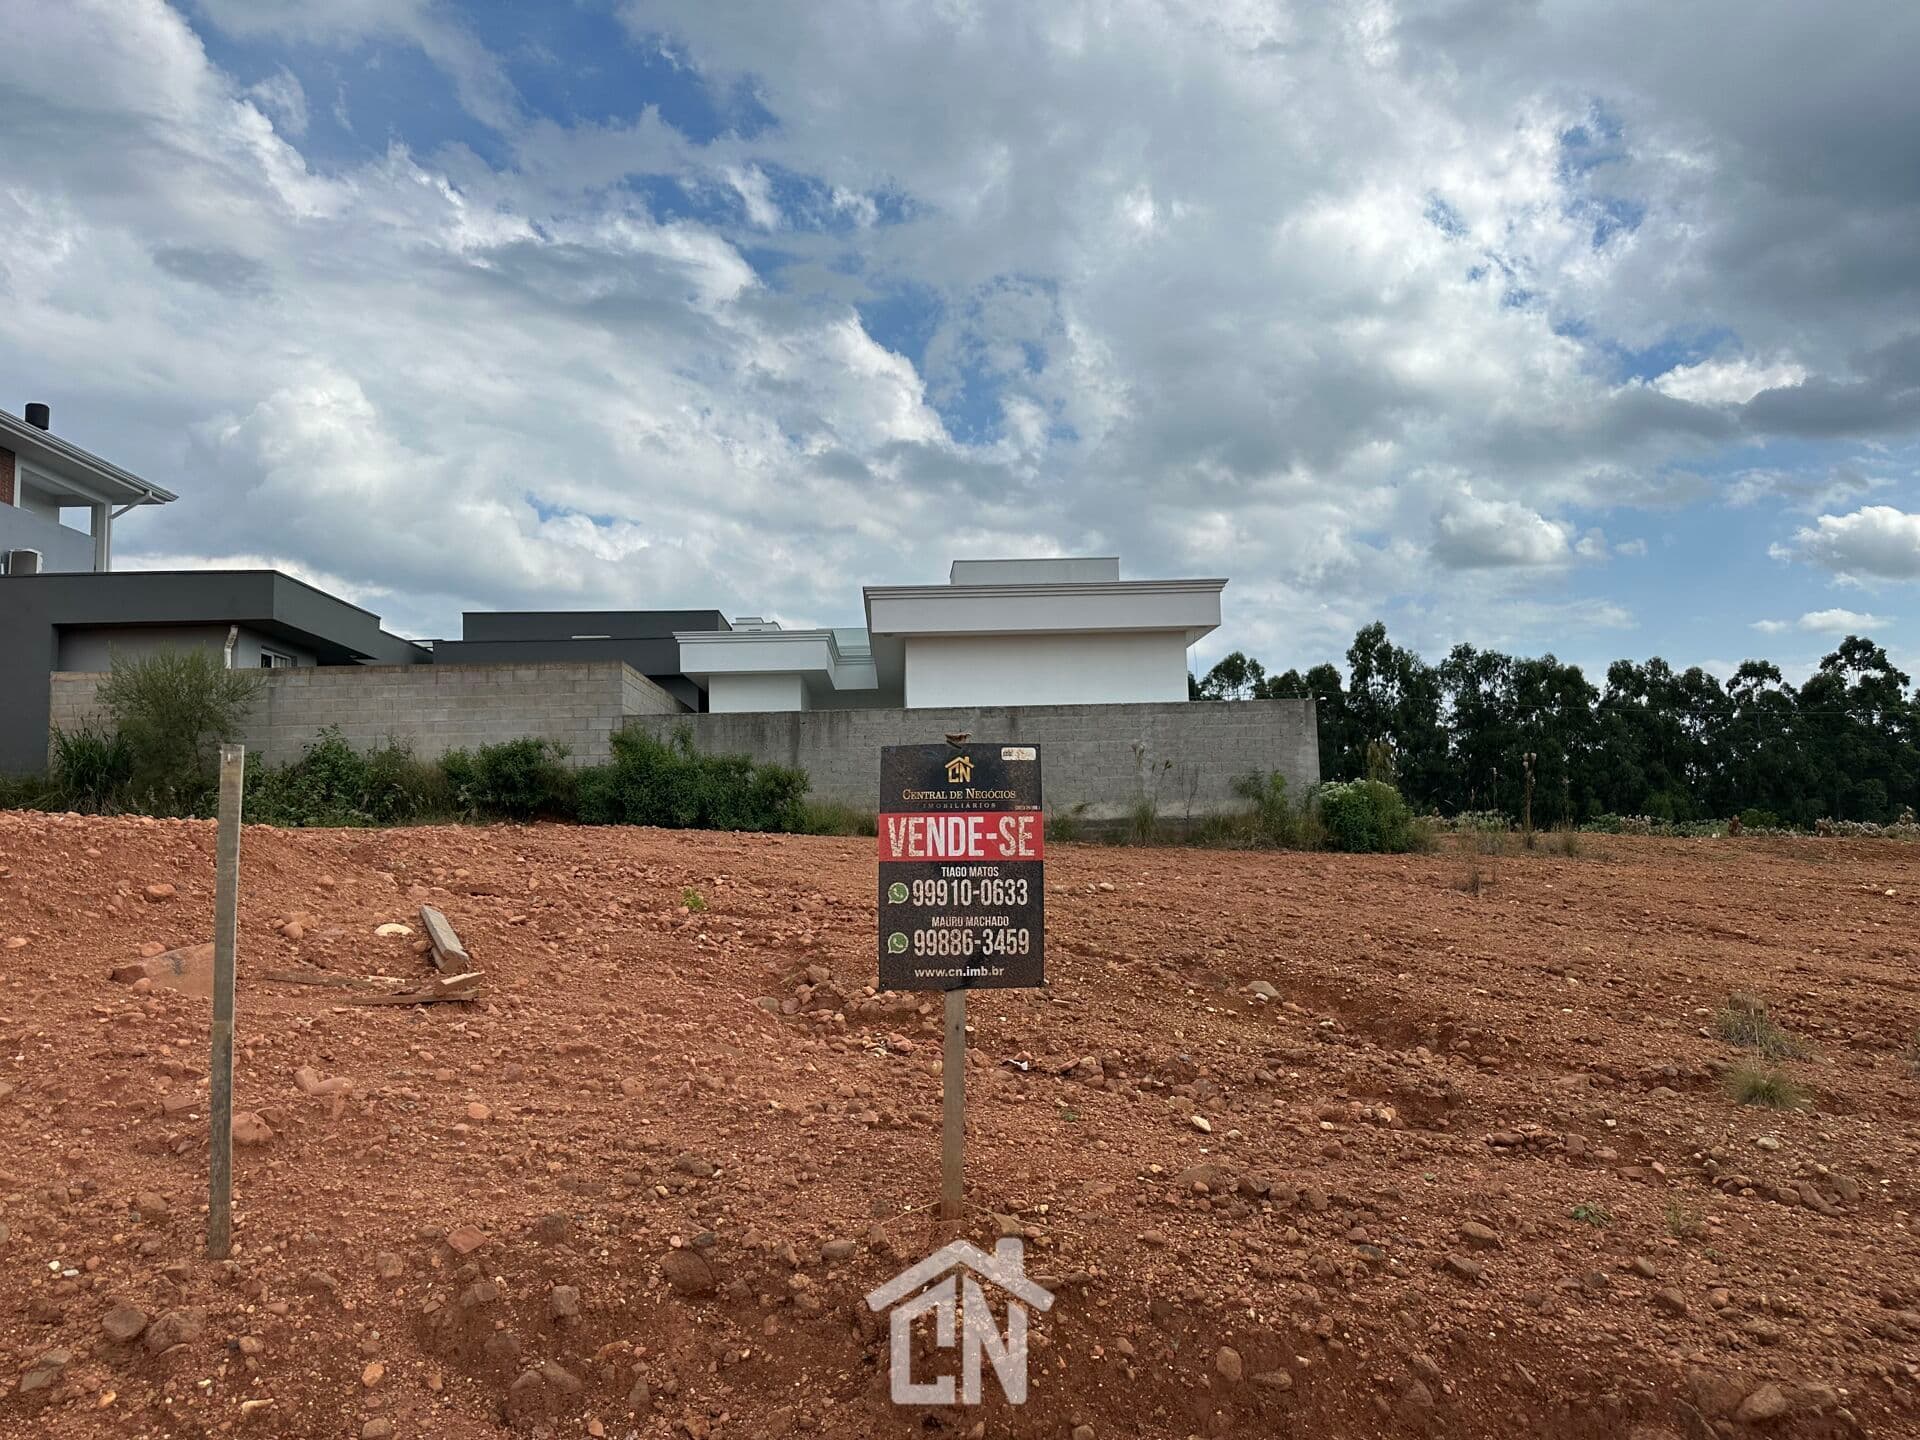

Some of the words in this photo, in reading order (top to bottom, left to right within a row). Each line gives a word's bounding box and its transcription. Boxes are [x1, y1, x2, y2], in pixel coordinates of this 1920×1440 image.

[888, 816, 1035, 857] VENDE-SE
[941, 867, 967, 877] TIAGO
[969, 866, 999, 877] MATOS
[912, 878, 1028, 906] 99910-0633
[931, 916, 964, 927] MAURO
[965, 916, 1009, 927] MACHADO
[913, 928, 1030, 956] 99886-3459
[914, 966, 1005, 977] www.cn.imb.br
